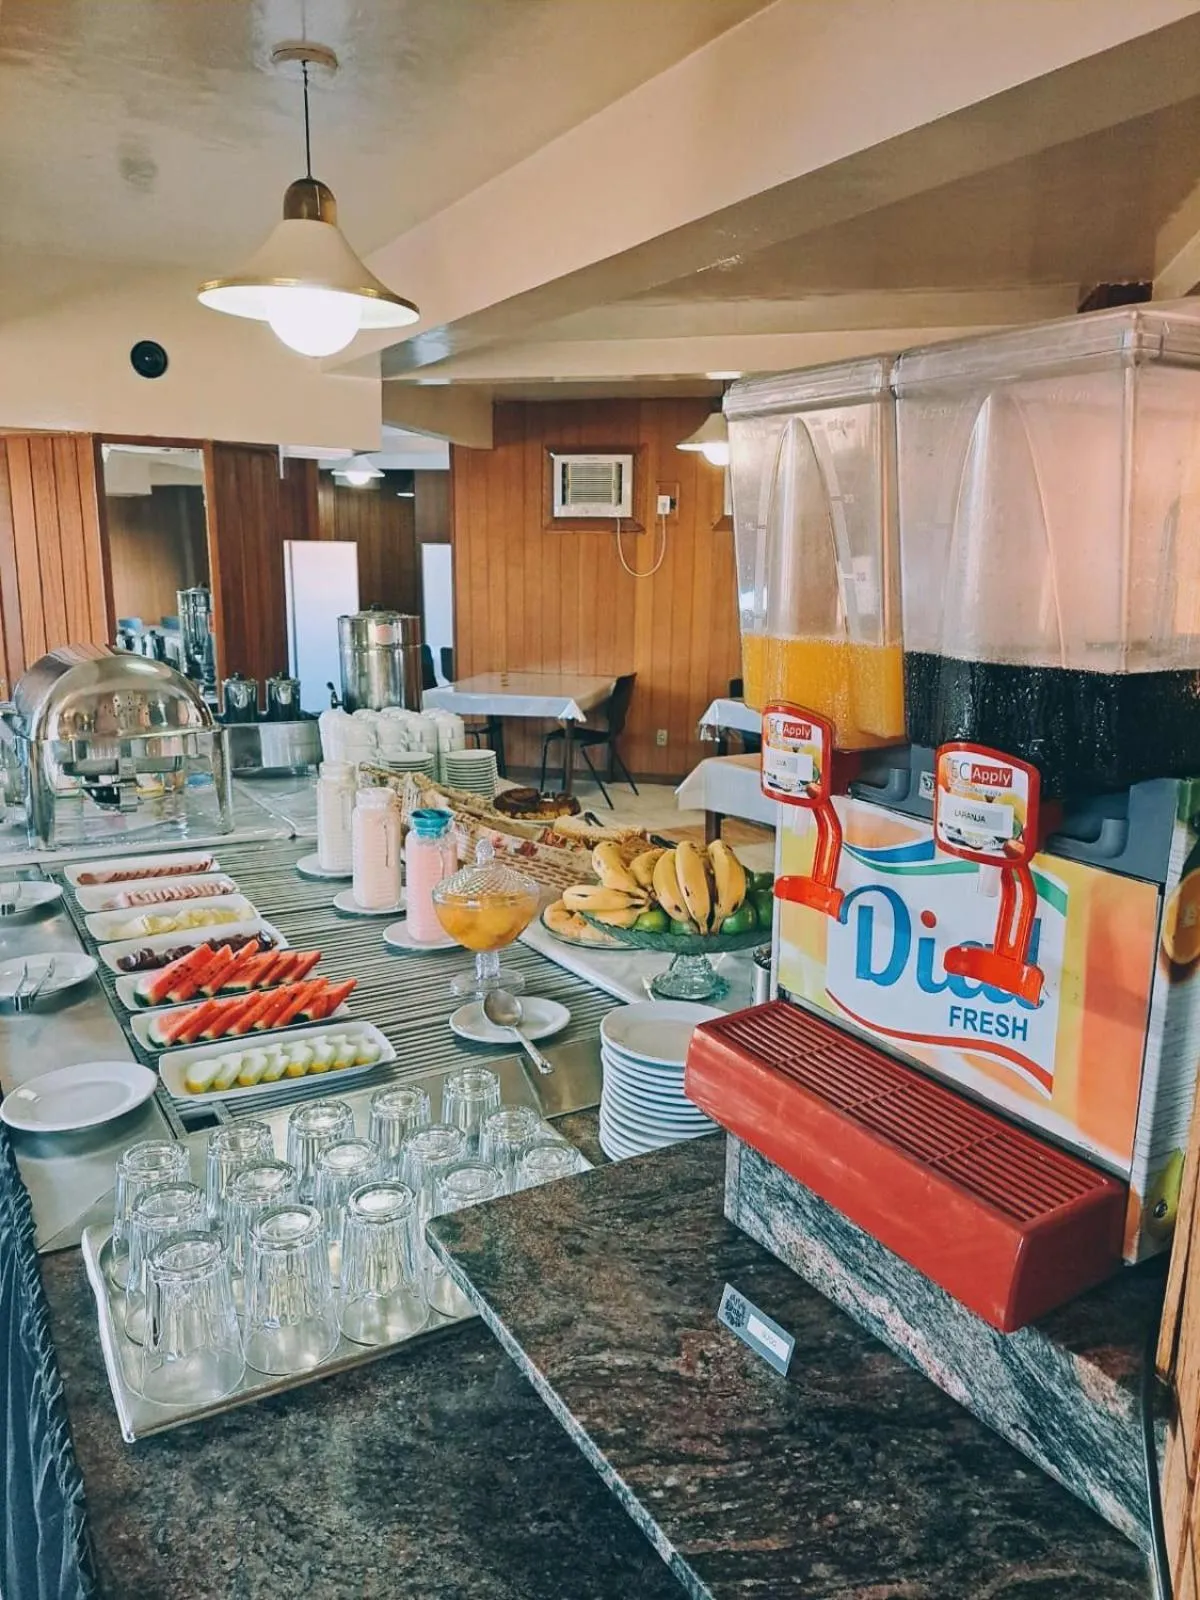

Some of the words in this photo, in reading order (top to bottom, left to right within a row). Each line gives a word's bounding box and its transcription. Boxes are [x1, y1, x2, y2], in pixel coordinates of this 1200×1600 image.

[782, 723, 811, 738] Apply
[973, 767, 1012, 786] Apply
[949, 1005, 1028, 1042] FRESH
